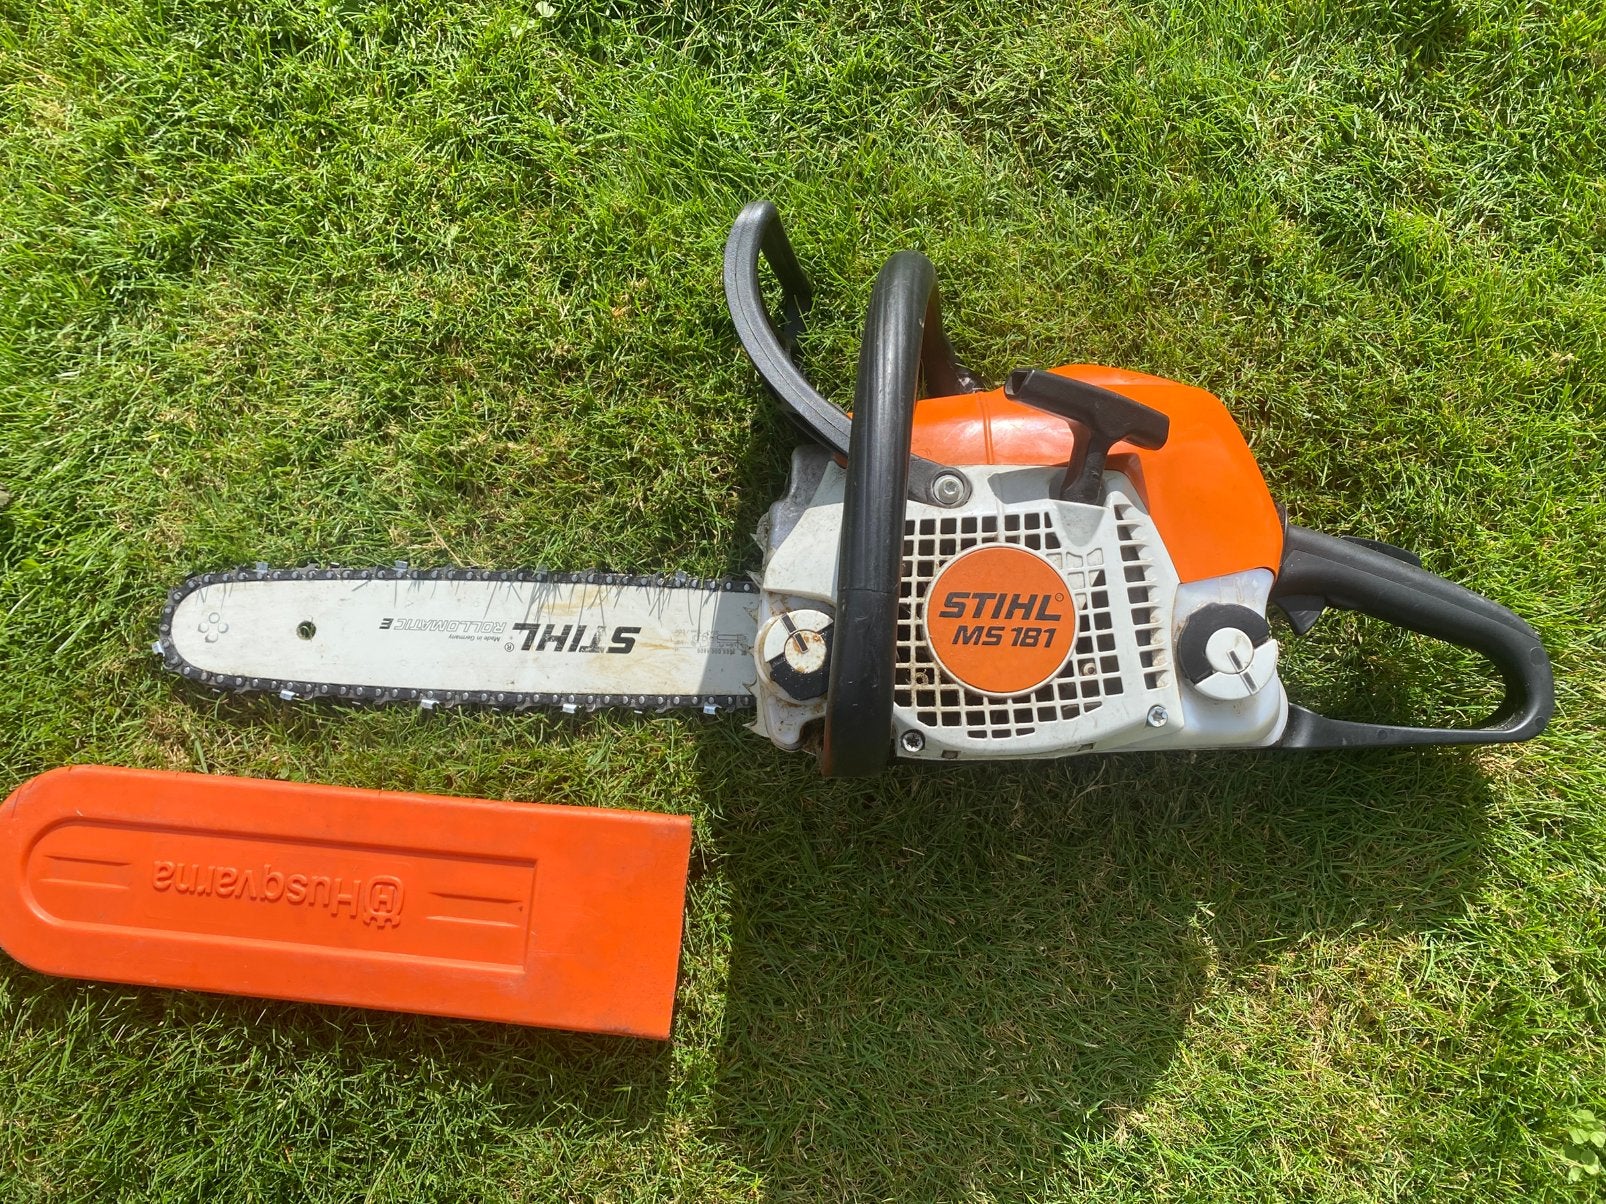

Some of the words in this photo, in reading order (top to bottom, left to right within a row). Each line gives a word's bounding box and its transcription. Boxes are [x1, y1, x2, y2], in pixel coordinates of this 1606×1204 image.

[379, 618, 394, 629] E
[394, 618, 507, 633] ROLLOMATIC
[448, 634, 475, 642] Germany
[952, 625, 1005, 646] MS
[1010, 627, 1057, 648] 181
[152, 860, 362, 919] Husqvarna
